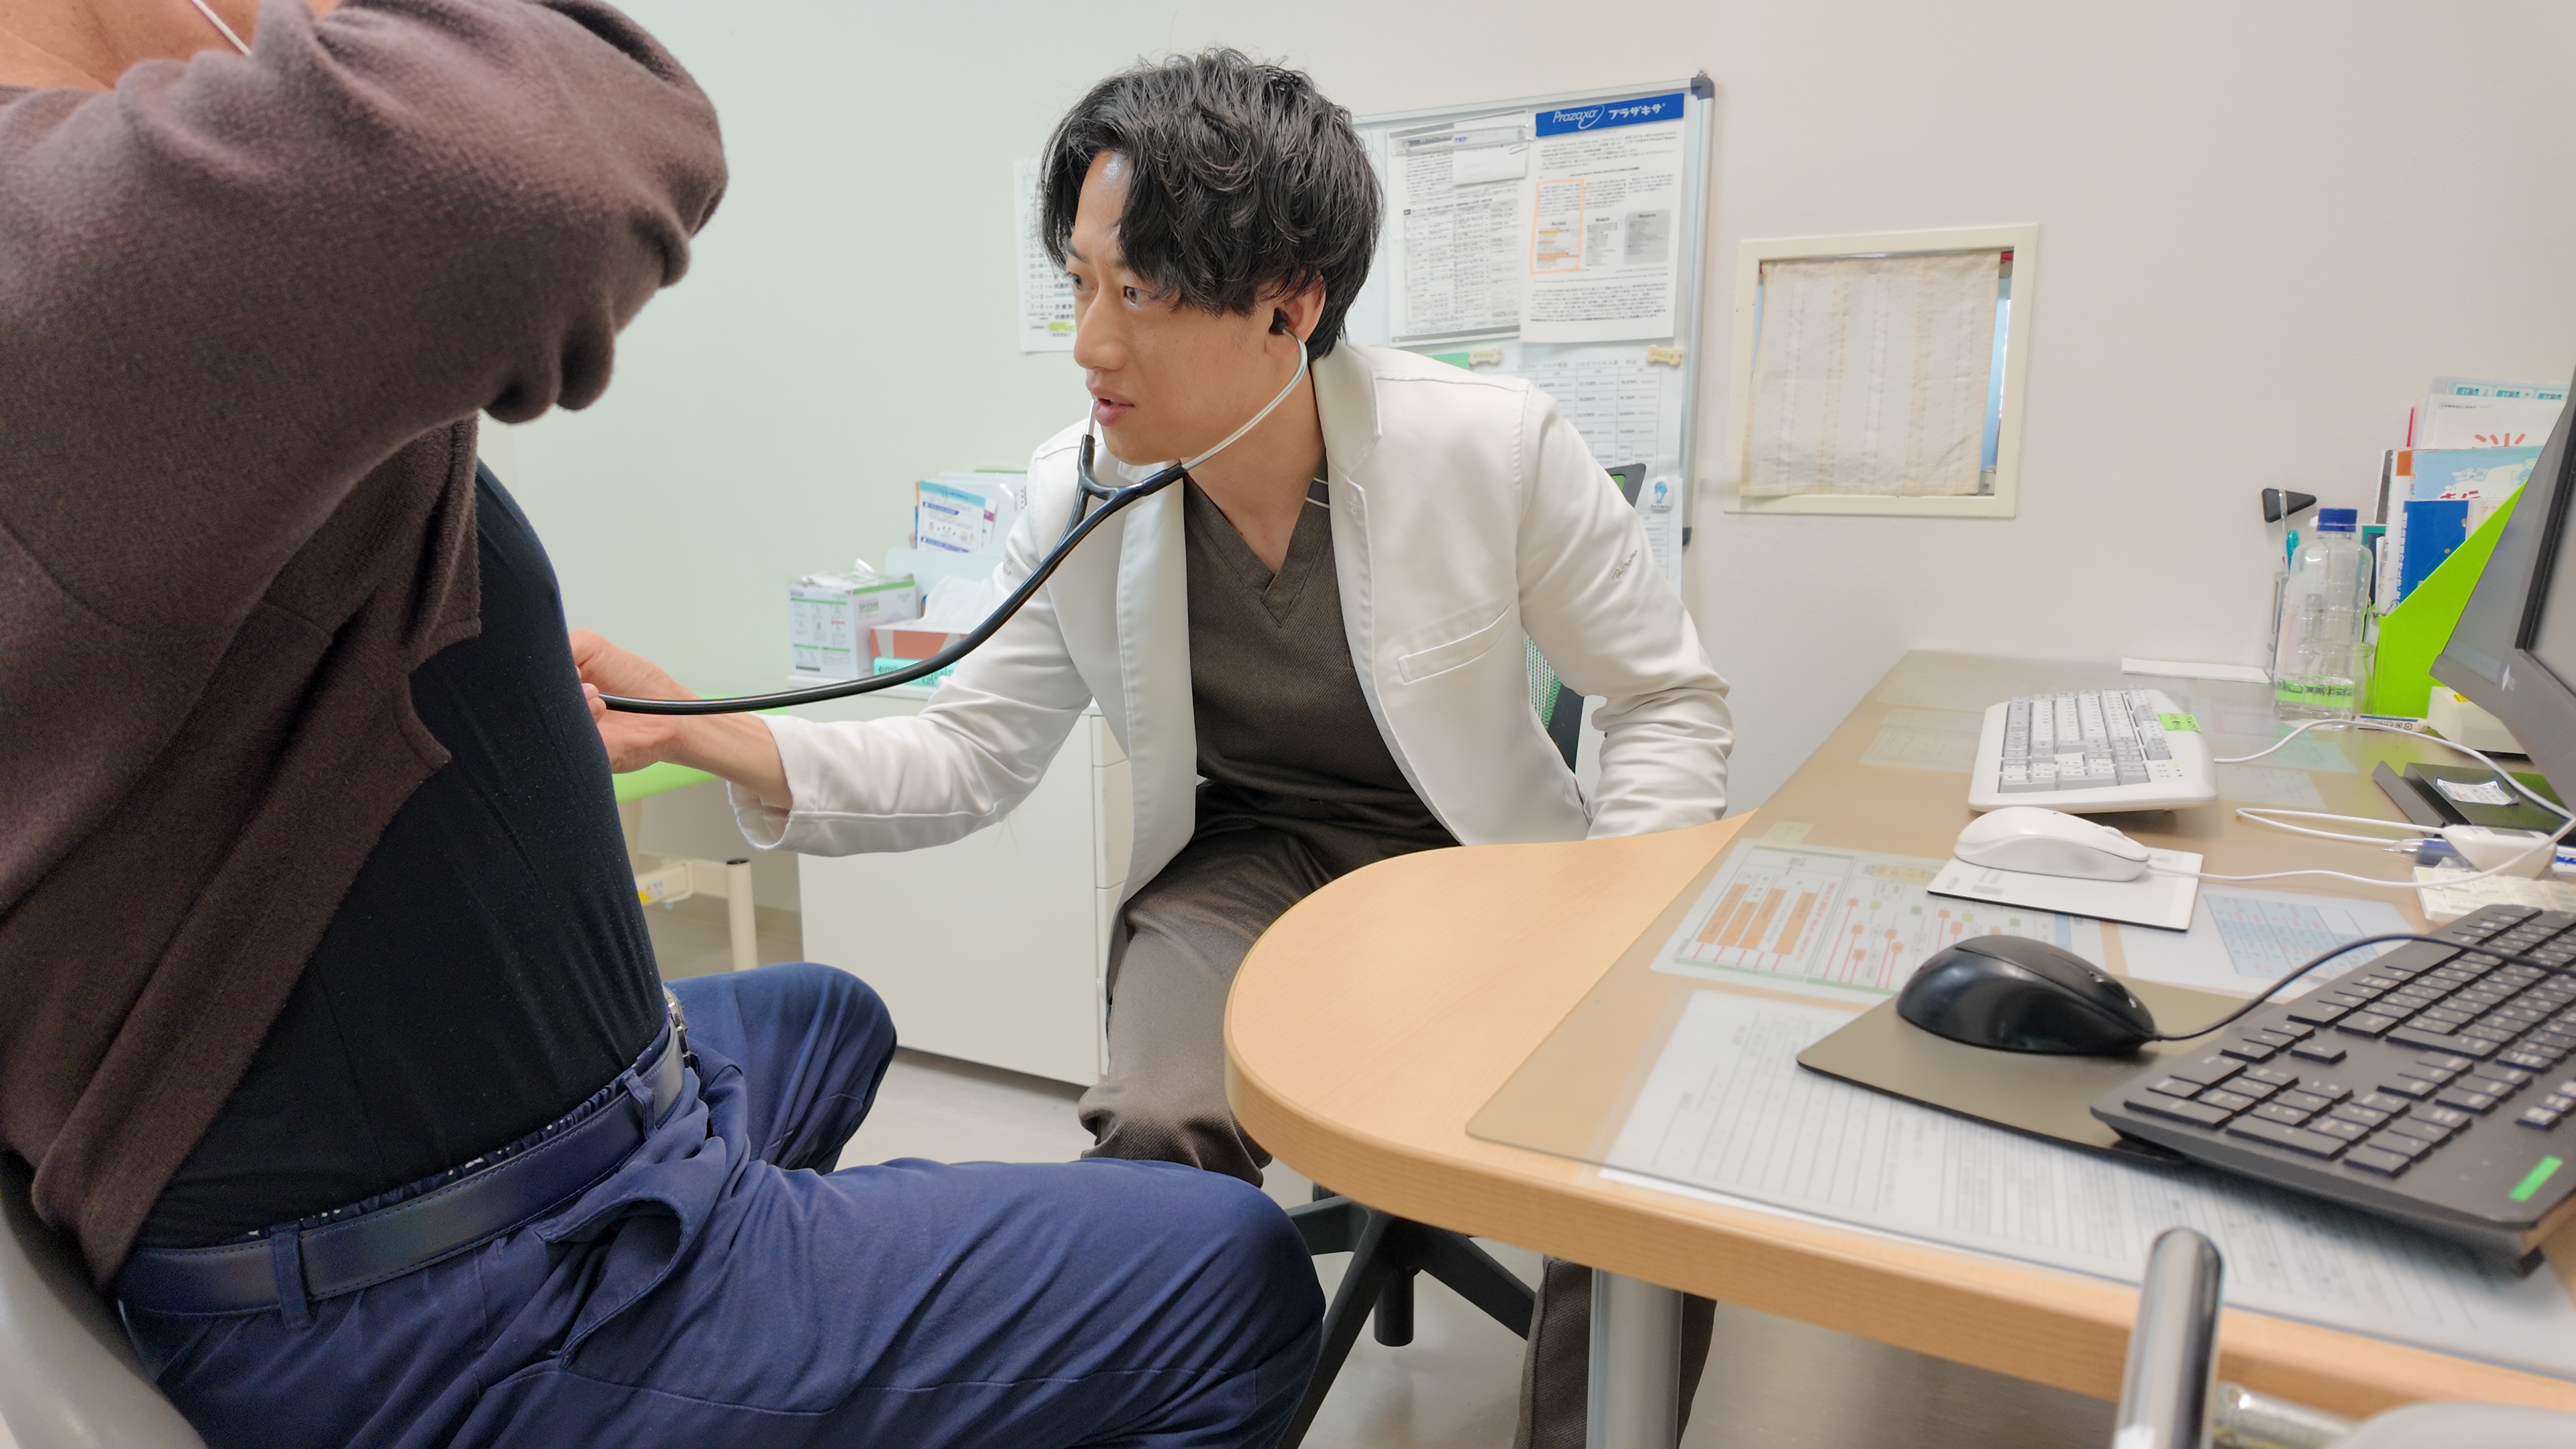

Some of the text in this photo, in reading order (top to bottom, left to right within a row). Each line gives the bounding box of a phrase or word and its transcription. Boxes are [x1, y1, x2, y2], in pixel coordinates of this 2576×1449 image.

[1552, 107, 1600, 126] Prazaxa
[1609, 103, 1662, 120] プラザキサ
